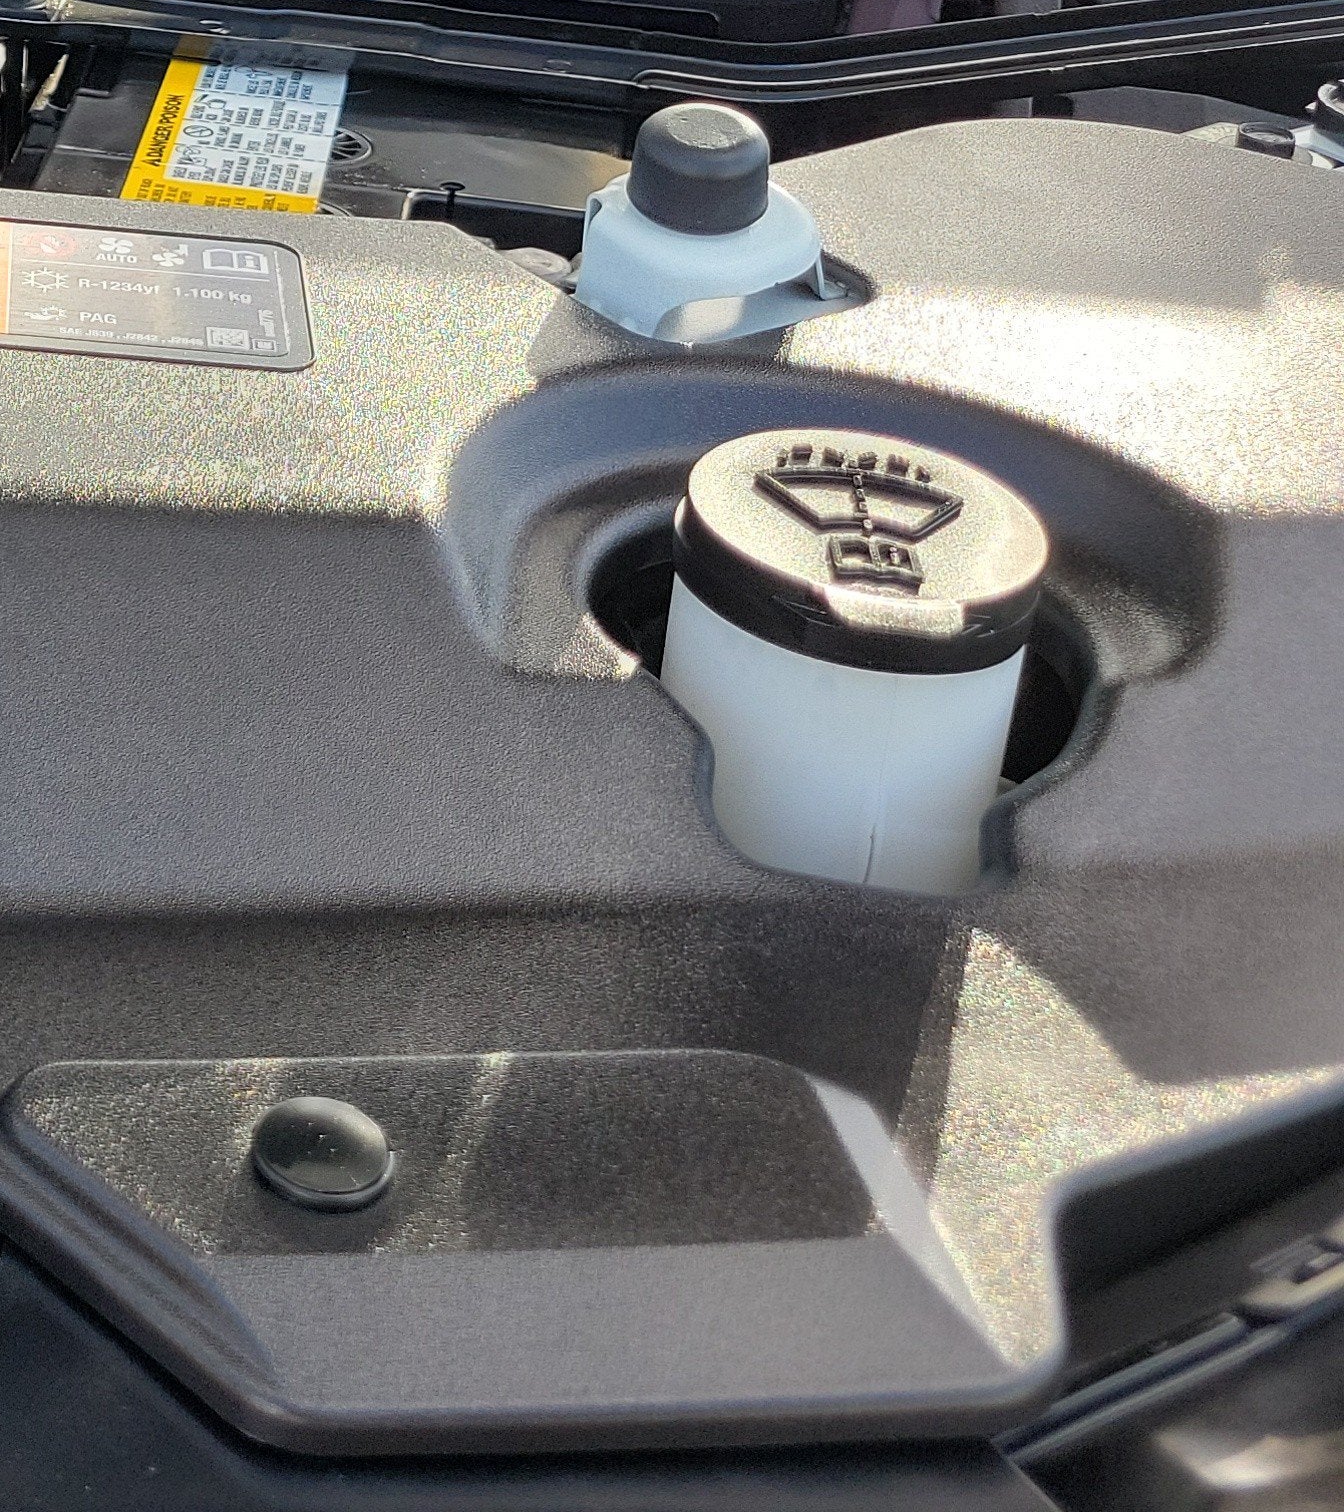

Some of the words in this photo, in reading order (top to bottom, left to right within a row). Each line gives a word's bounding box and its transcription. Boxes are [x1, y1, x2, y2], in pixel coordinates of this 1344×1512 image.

[95, 252, 138, 264] AUTO
[78, 278, 161, 297] R-1234yf
[172, 287, 225, 301] 1.100
[228, 290, 253, 305] kg
[79, 311, 118, 325] PAG
[59, 327, 82, 336] SAE
